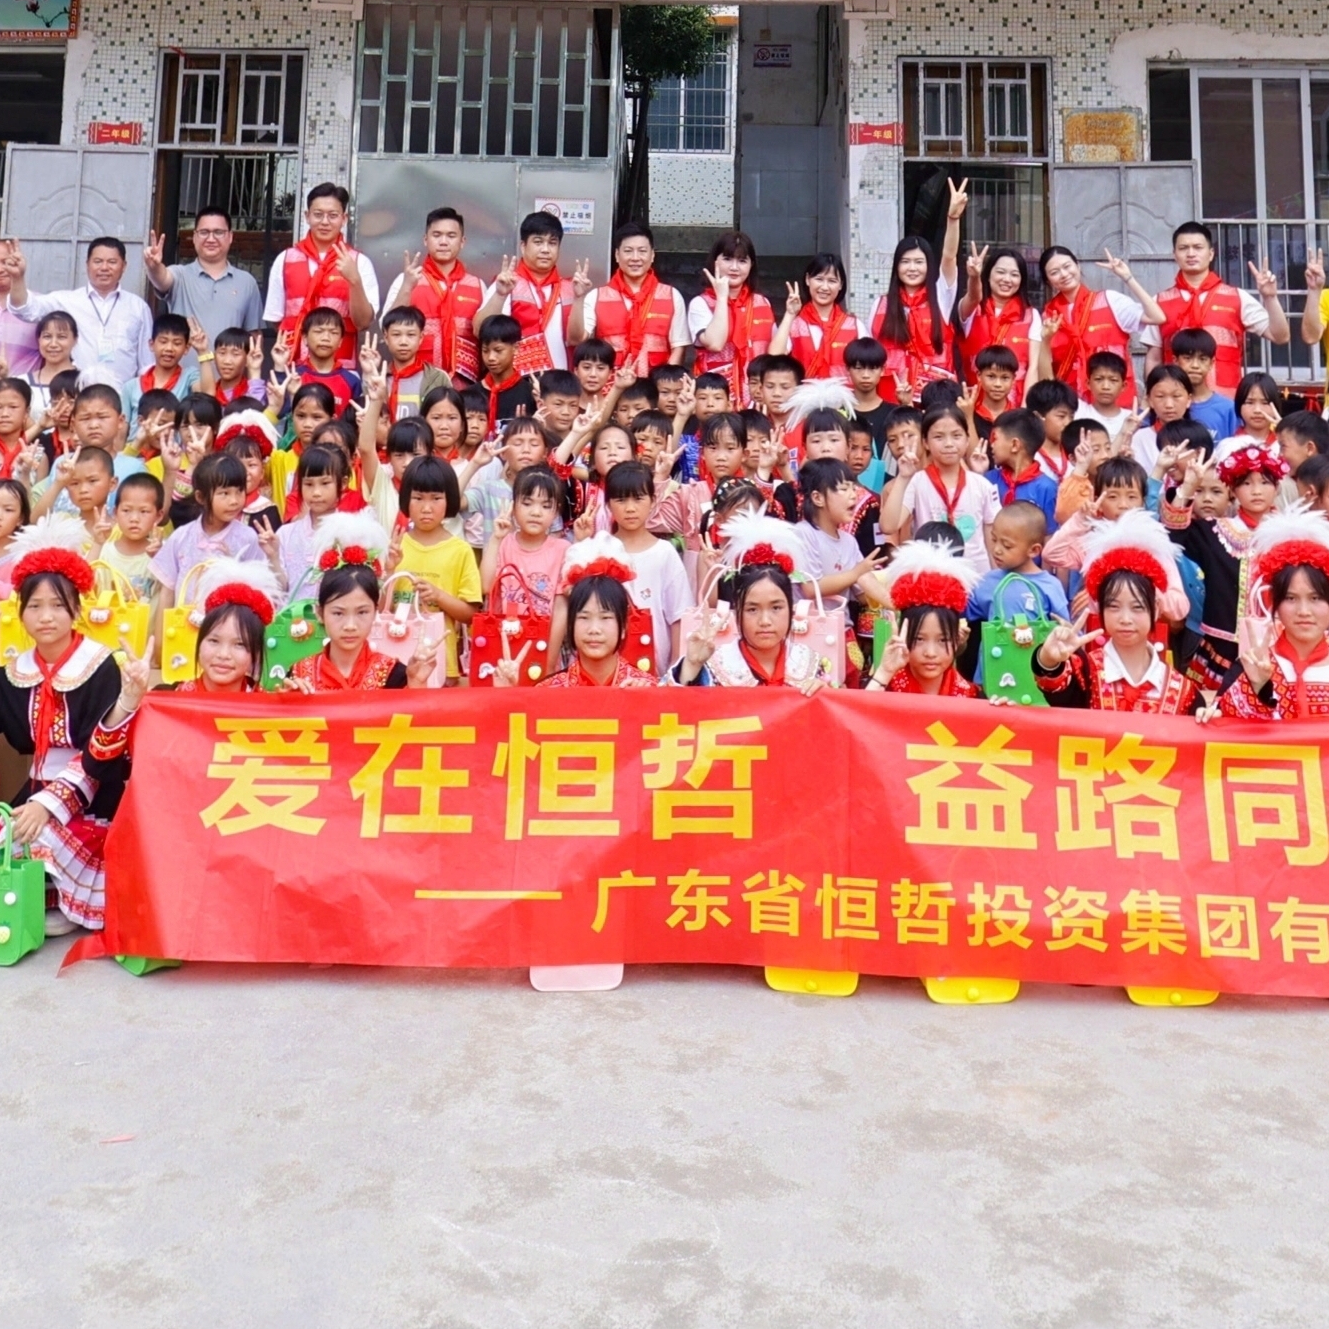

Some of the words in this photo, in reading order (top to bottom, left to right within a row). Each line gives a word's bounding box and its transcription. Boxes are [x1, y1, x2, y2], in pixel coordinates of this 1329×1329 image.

[100, 128, 132, 141] 二年级
[862, 128, 893, 141] 一年级
[199, 711, 768, 841] 爱在恒哲
